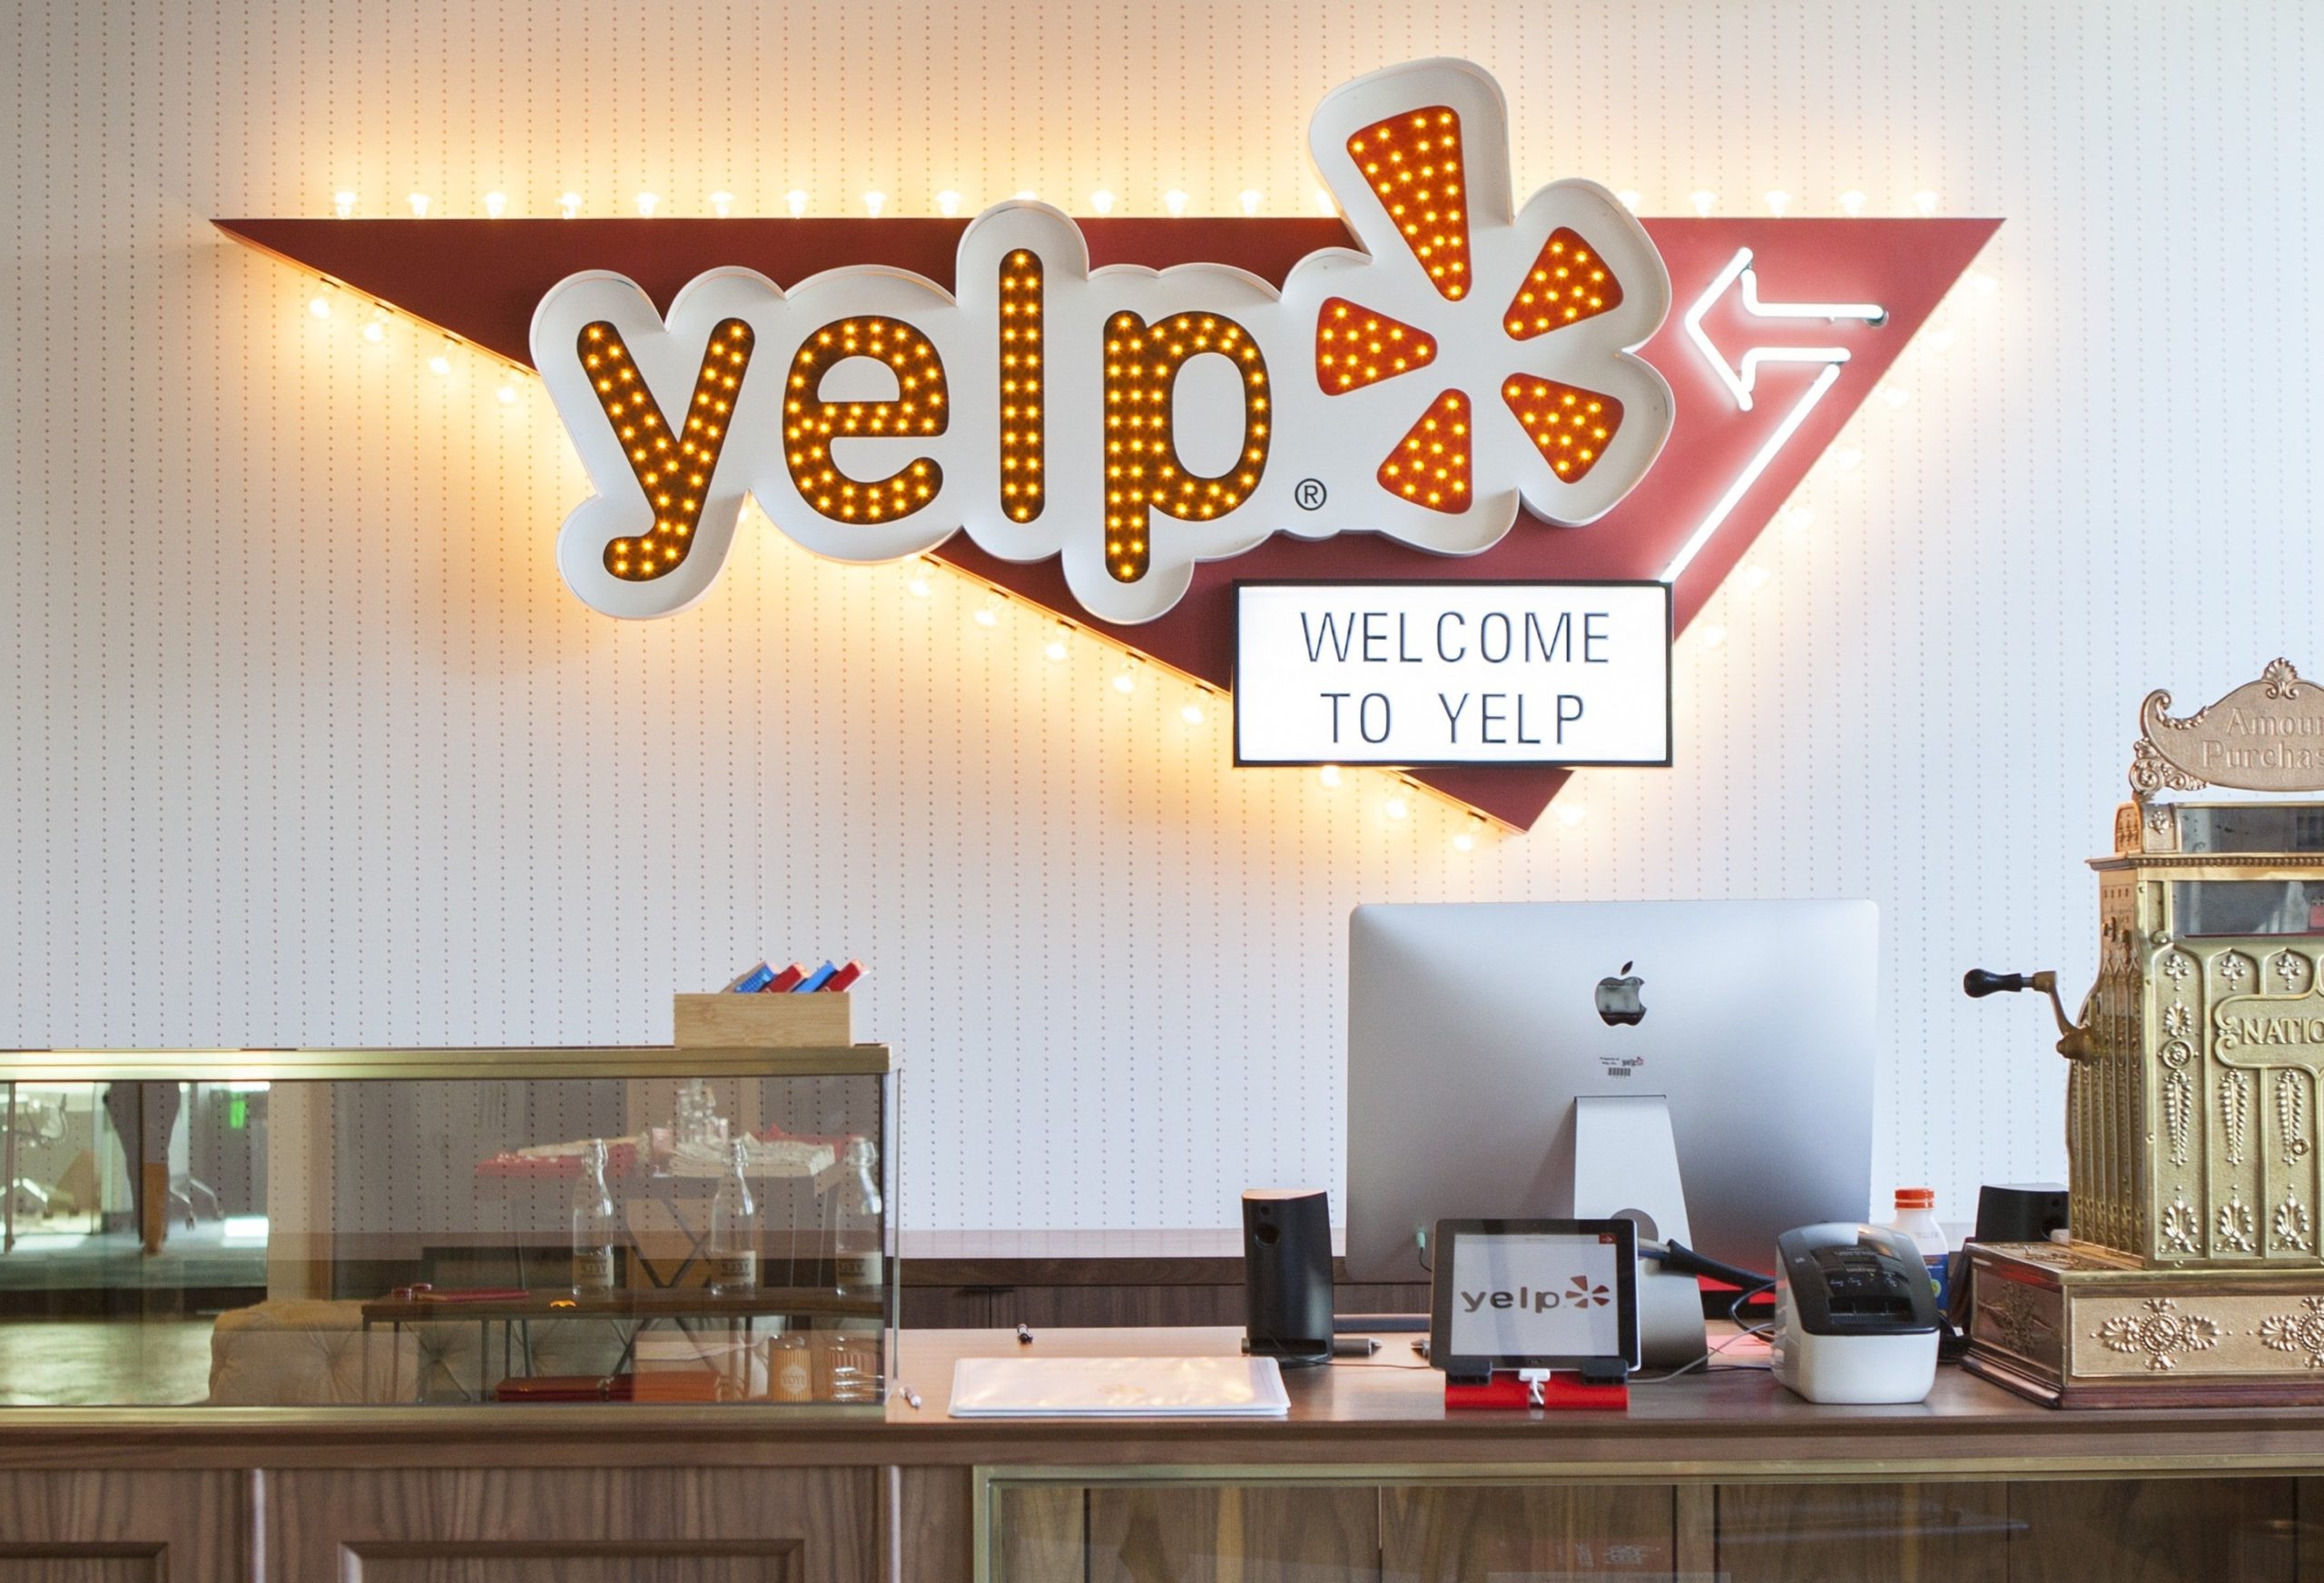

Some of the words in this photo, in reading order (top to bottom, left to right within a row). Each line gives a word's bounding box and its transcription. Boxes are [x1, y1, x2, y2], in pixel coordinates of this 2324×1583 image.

[576, 248, 1272, 584] yelp
[1300, 611, 1610, 664] WELCOME
[1320, 692, 1392, 744] TO
[1438, 692, 1584, 744] YELP
[1461, 1286, 1561, 1313] yelp
